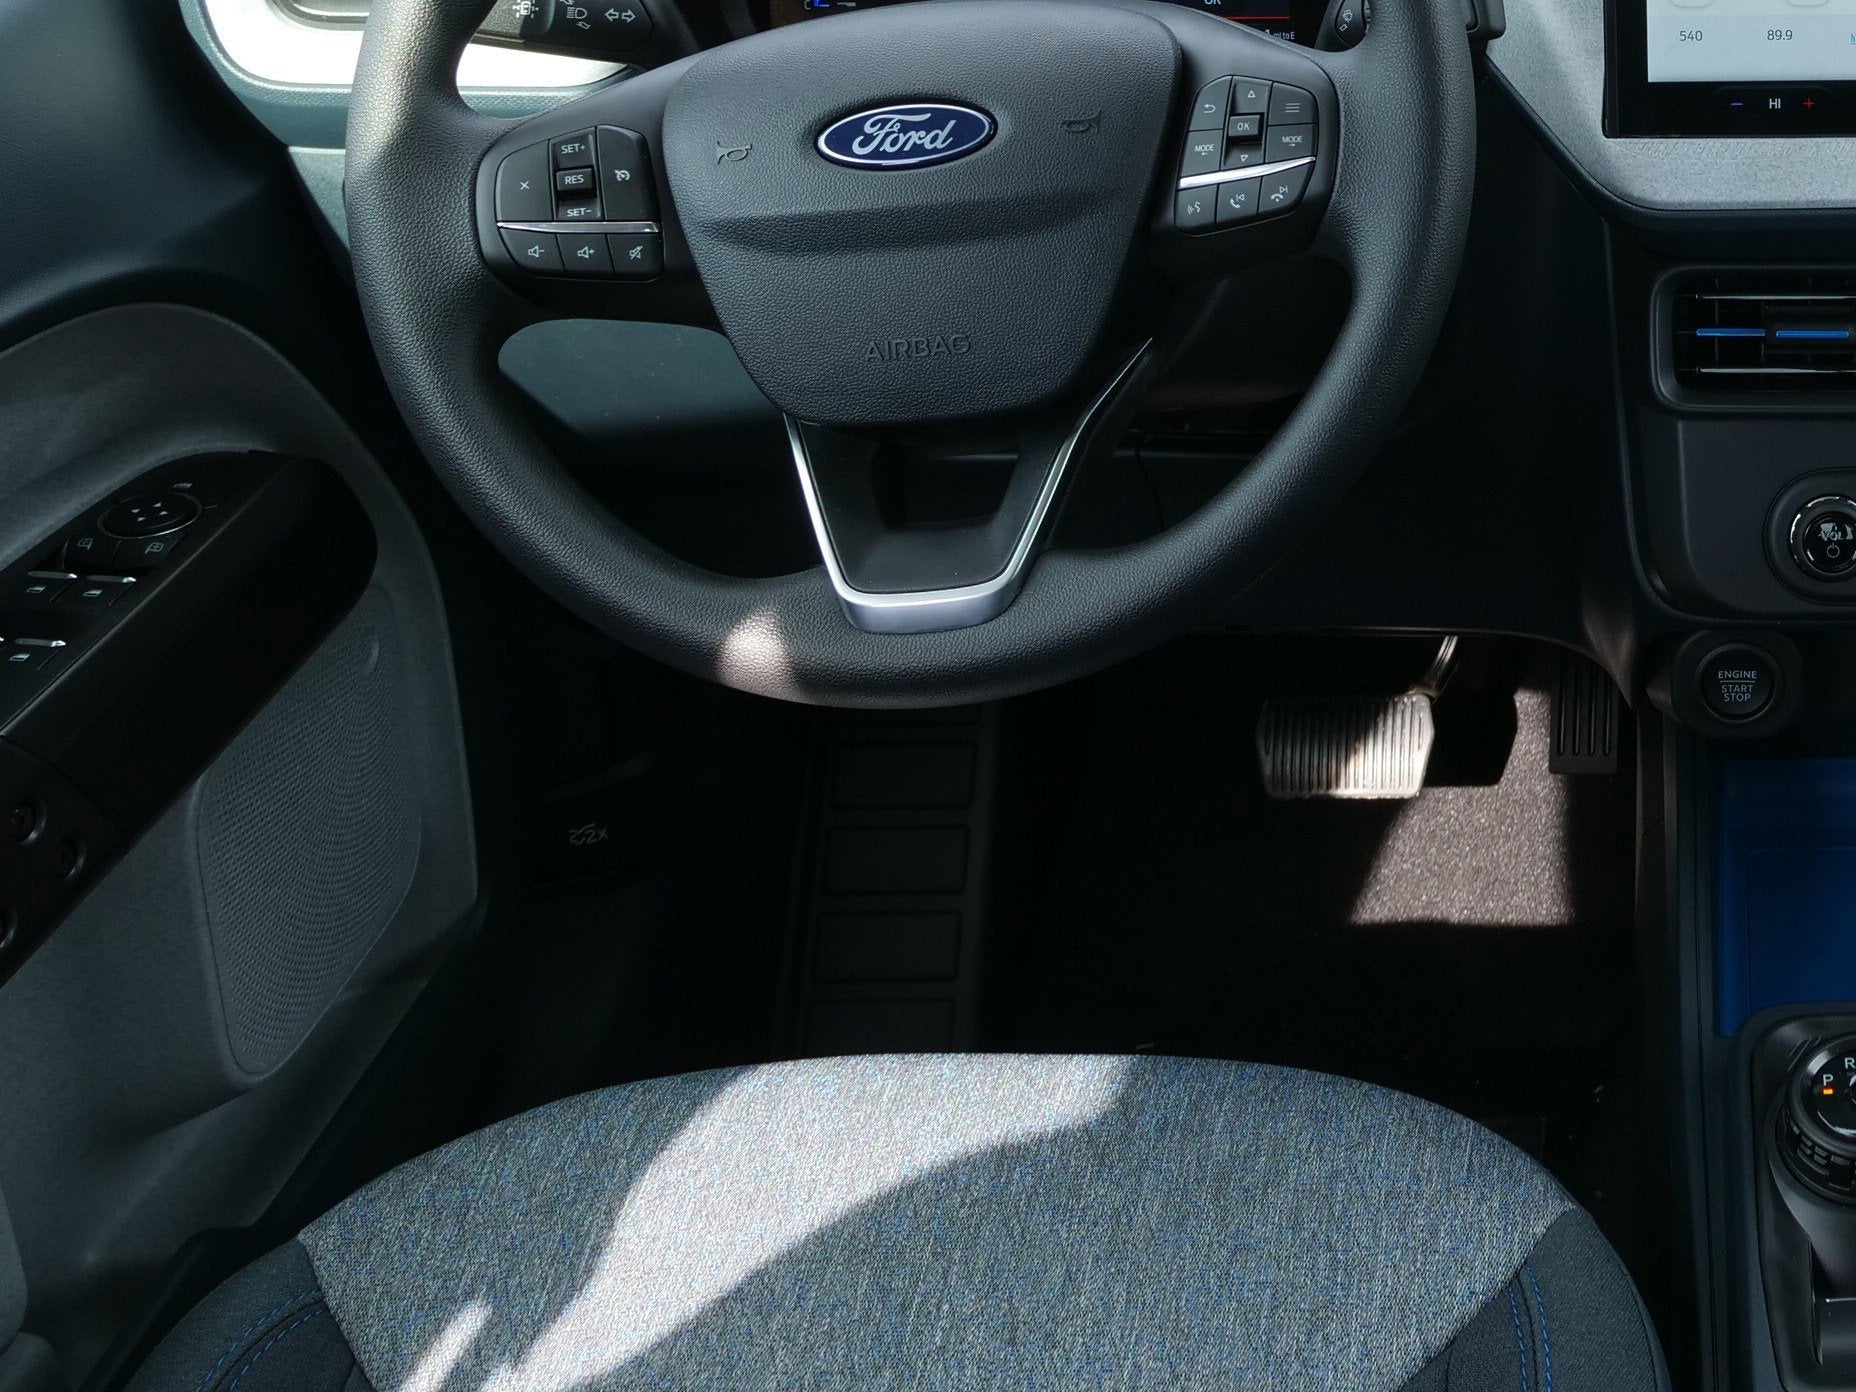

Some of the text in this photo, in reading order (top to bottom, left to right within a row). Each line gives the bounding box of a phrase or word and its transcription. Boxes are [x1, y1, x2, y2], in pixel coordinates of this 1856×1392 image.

[1679, 29, 1793, 42] 540 89.9
[1769, 98, 1781, 109] HI
[1237, 123, 1250, 131] OK
[852, 113, 957, 155] Ford
[1282, 135, 1303, 144] MODE
[1194, 143, 1215, 152] MODE
[564, 174, 584, 185] RES
[865, 334, 970, 362] AIRBAG
[1820, 531, 1844, 542] VOL
[1718, 670, 1758, 679] ENGINE
[1721, 684, 1754, 693] START
[1724, 693, 1751, 702] STOP
[1844, 1057, 1856, 1070] R
[1822, 1074, 1834, 1087] P
